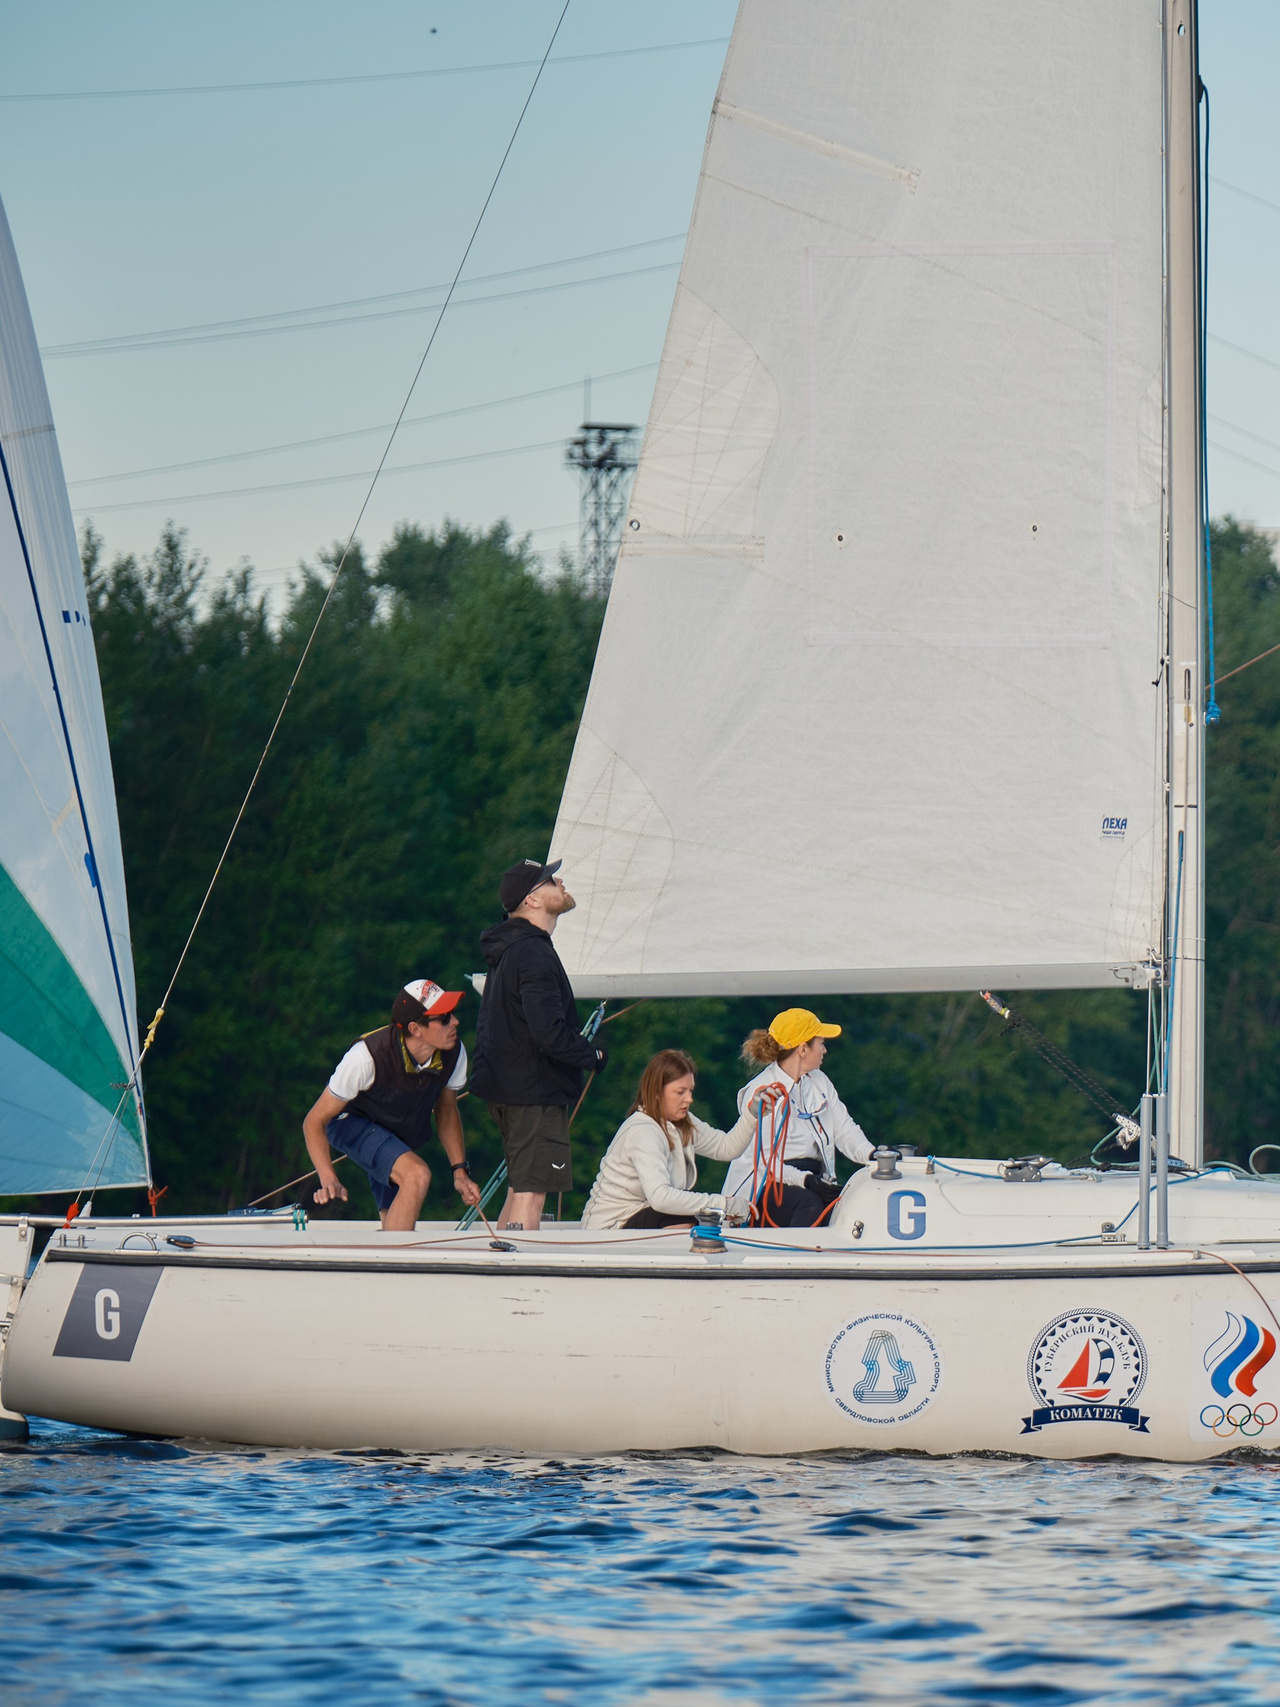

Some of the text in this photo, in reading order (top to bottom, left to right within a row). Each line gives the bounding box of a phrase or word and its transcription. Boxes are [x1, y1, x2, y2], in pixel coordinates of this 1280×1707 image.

[887, 1190, 926, 1240] G
[94, 1288, 120, 1340] G
[825, 1330, 846, 1392] МИНИСТЕРСТВО
[846, 1313, 903, 1330] ФИЗИЧЕСКОЙ
[905, 1319, 935, 1351] КУЛЬТУРЫ
[930, 1361, 940, 1393] СПОРТА
[1044, 1323, 1131, 1372] ГУБЕРНСКИЙ ЯХТ-КЛУБ
[835, 1397, 930, 1424] СВЕРДЛОВСКОЙ ОБЛАСТИ
[1050, 1407, 1123, 1420] КОМАТЕК
